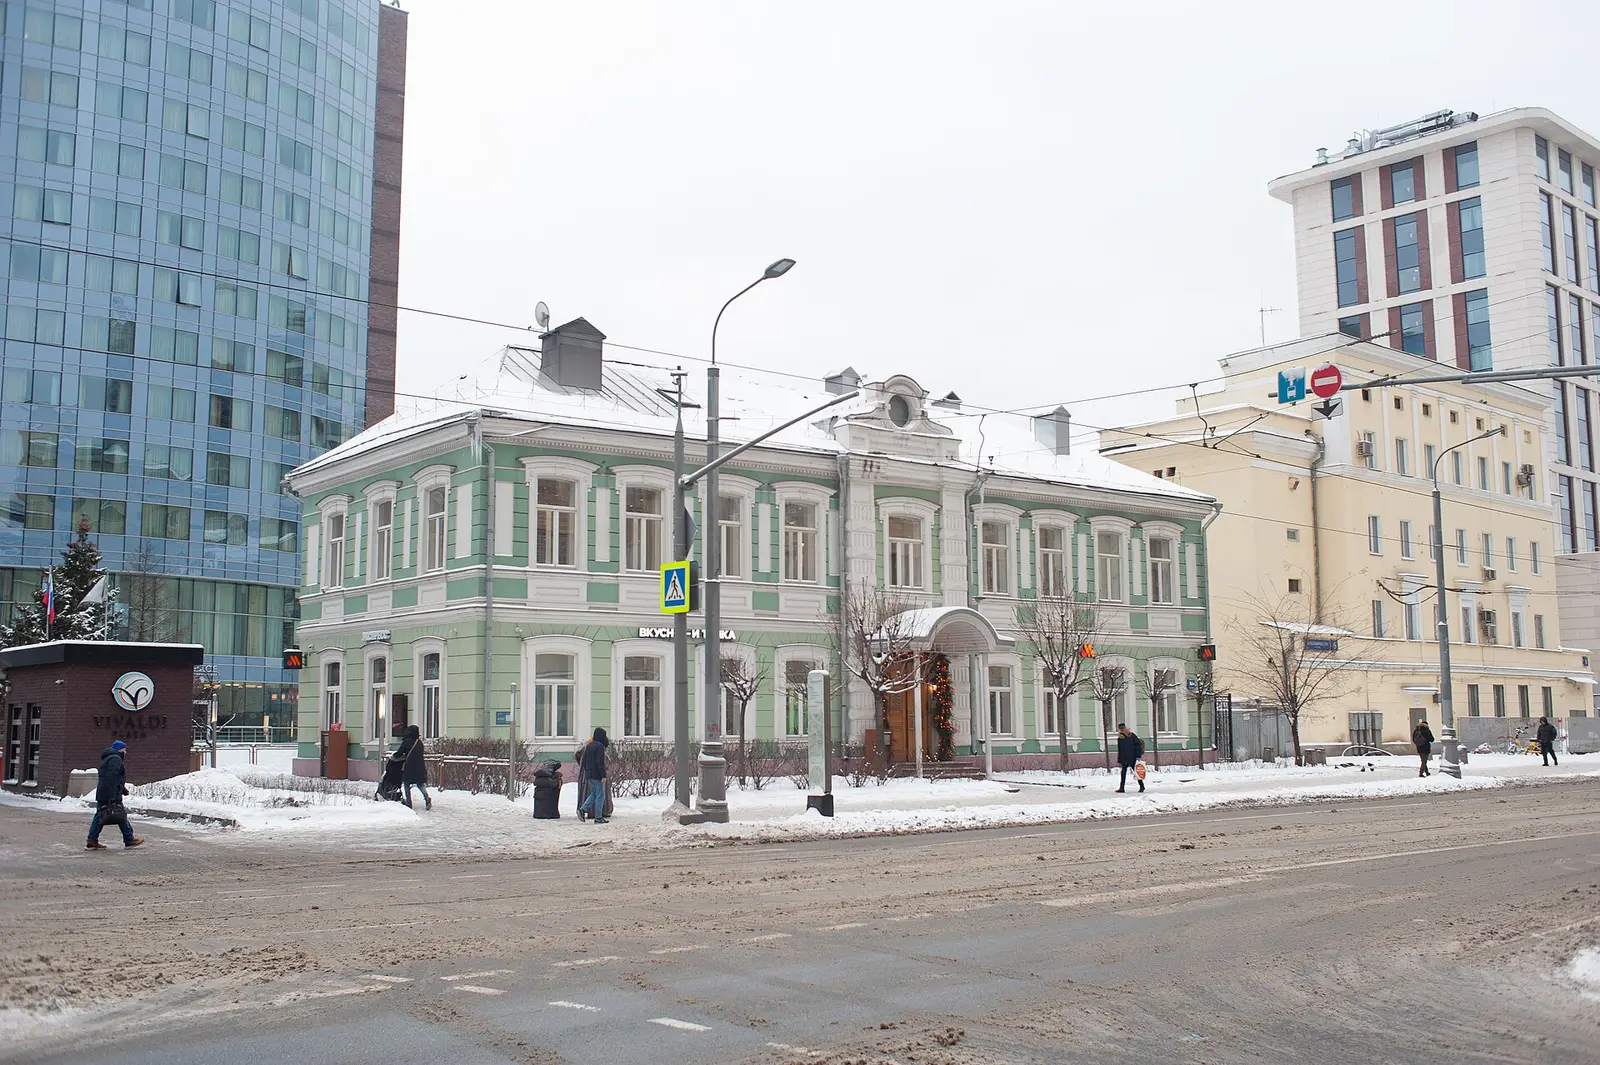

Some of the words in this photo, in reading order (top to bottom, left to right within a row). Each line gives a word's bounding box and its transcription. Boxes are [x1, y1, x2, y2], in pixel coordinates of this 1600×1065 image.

[639, 628, 681, 639] ВКУСН
[702, 630, 736, 640] ТКА
[94, 714, 167, 729] VIVALDI
